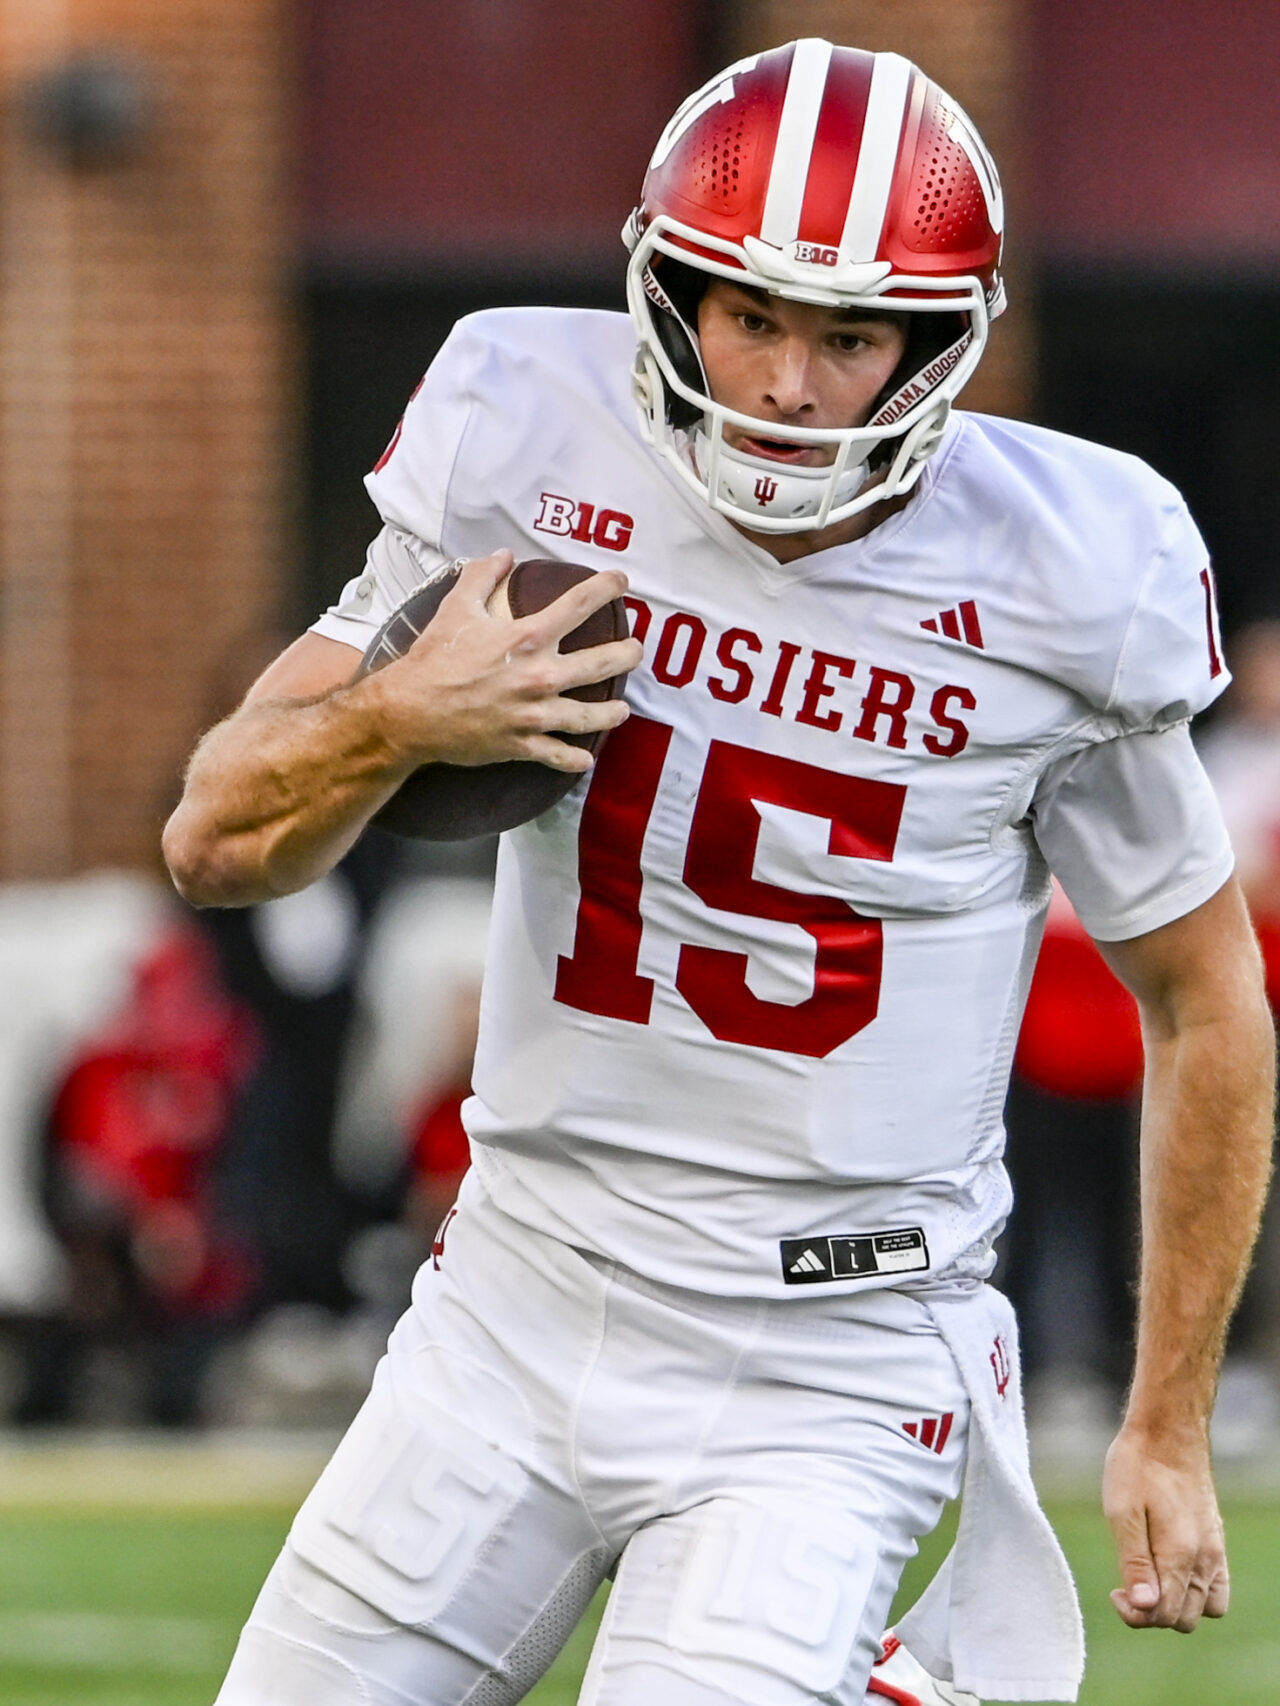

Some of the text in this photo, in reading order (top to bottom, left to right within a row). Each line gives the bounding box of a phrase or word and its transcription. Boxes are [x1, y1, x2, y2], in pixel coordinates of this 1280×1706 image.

[872, 334, 973, 426] NDIANA HOOSIE
[622, 596, 977, 758] OSIERS
[553, 713, 908, 1059] 15
